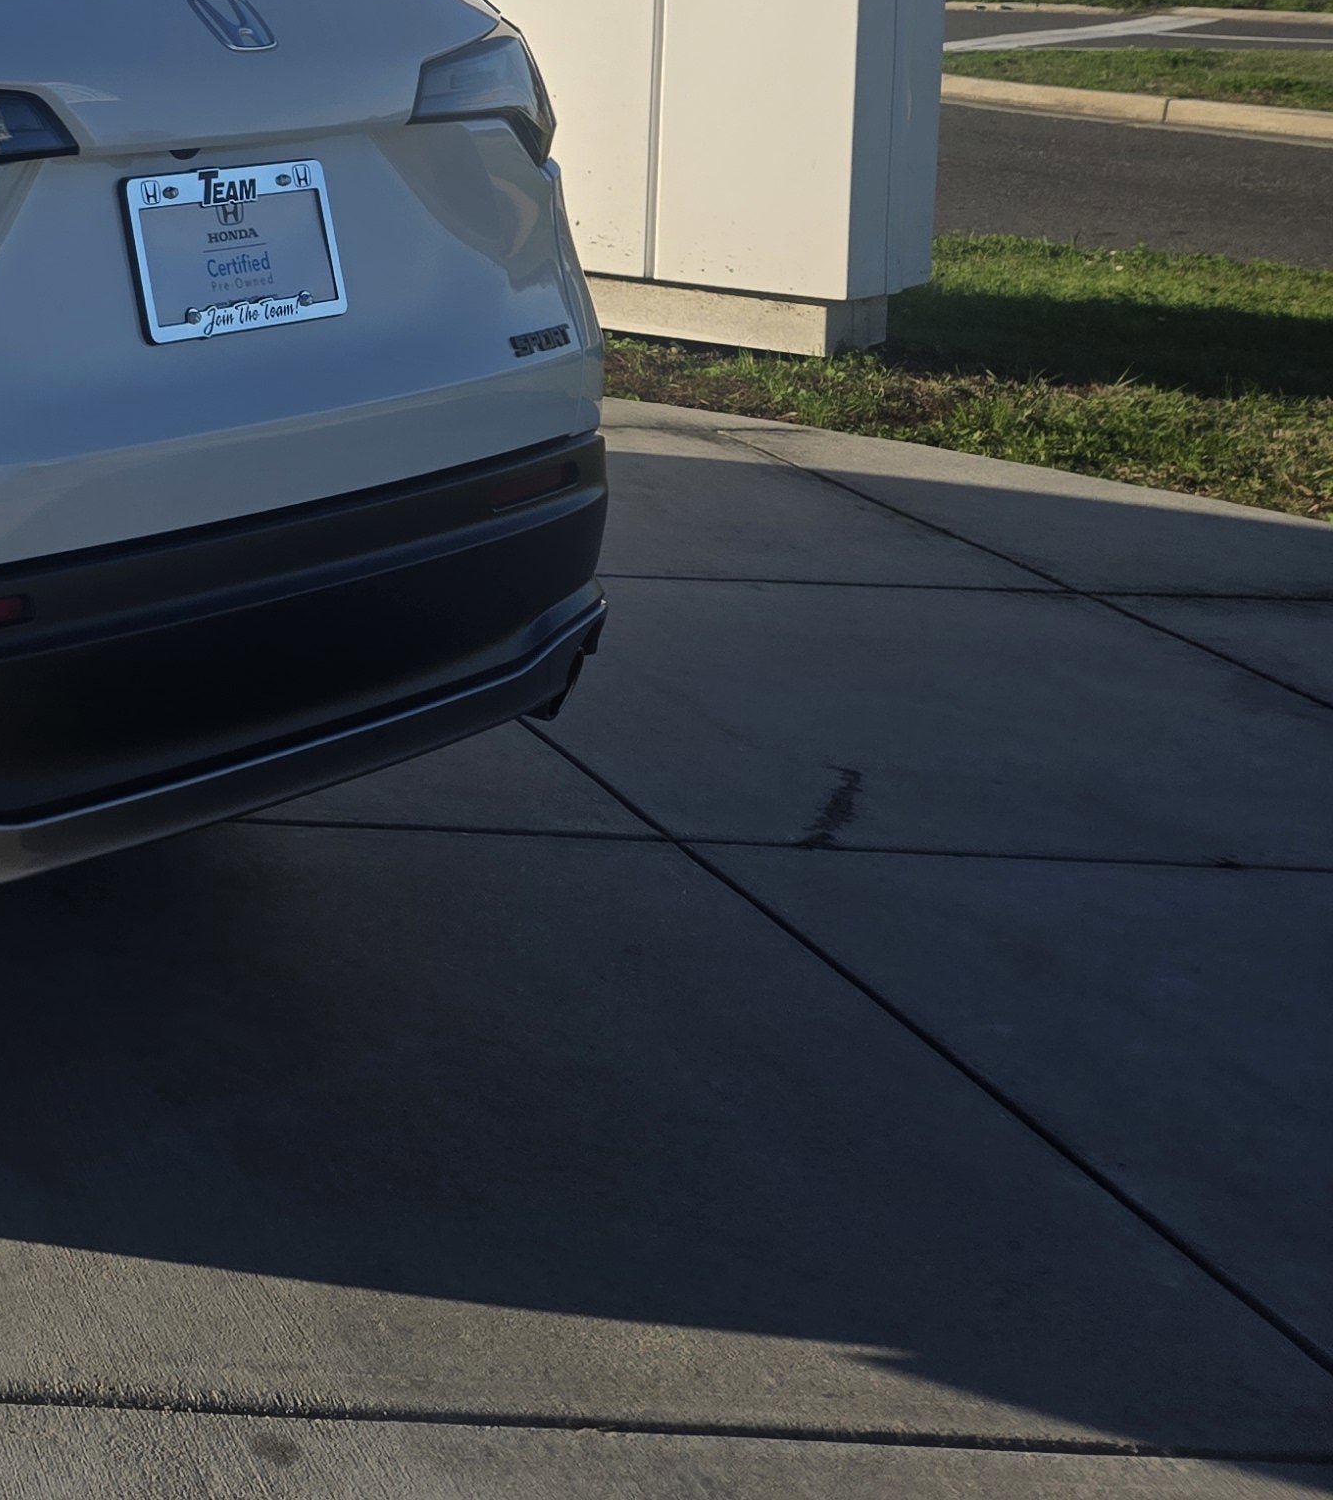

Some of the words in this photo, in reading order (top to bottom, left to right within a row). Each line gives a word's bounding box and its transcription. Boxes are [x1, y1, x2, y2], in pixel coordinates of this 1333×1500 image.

[198, 169, 257, 205] TEAM
[207, 228, 259, 243] HONDA
[207, 252, 271, 277] Certified
[211, 280, 231, 293] Pre
[235, 275, 275, 289] Owned
[204, 308, 234, 335] Join
[235, 303, 260, 323] The
[260, 299, 300, 320] Team!
[509, 323, 572, 358] SPORT
